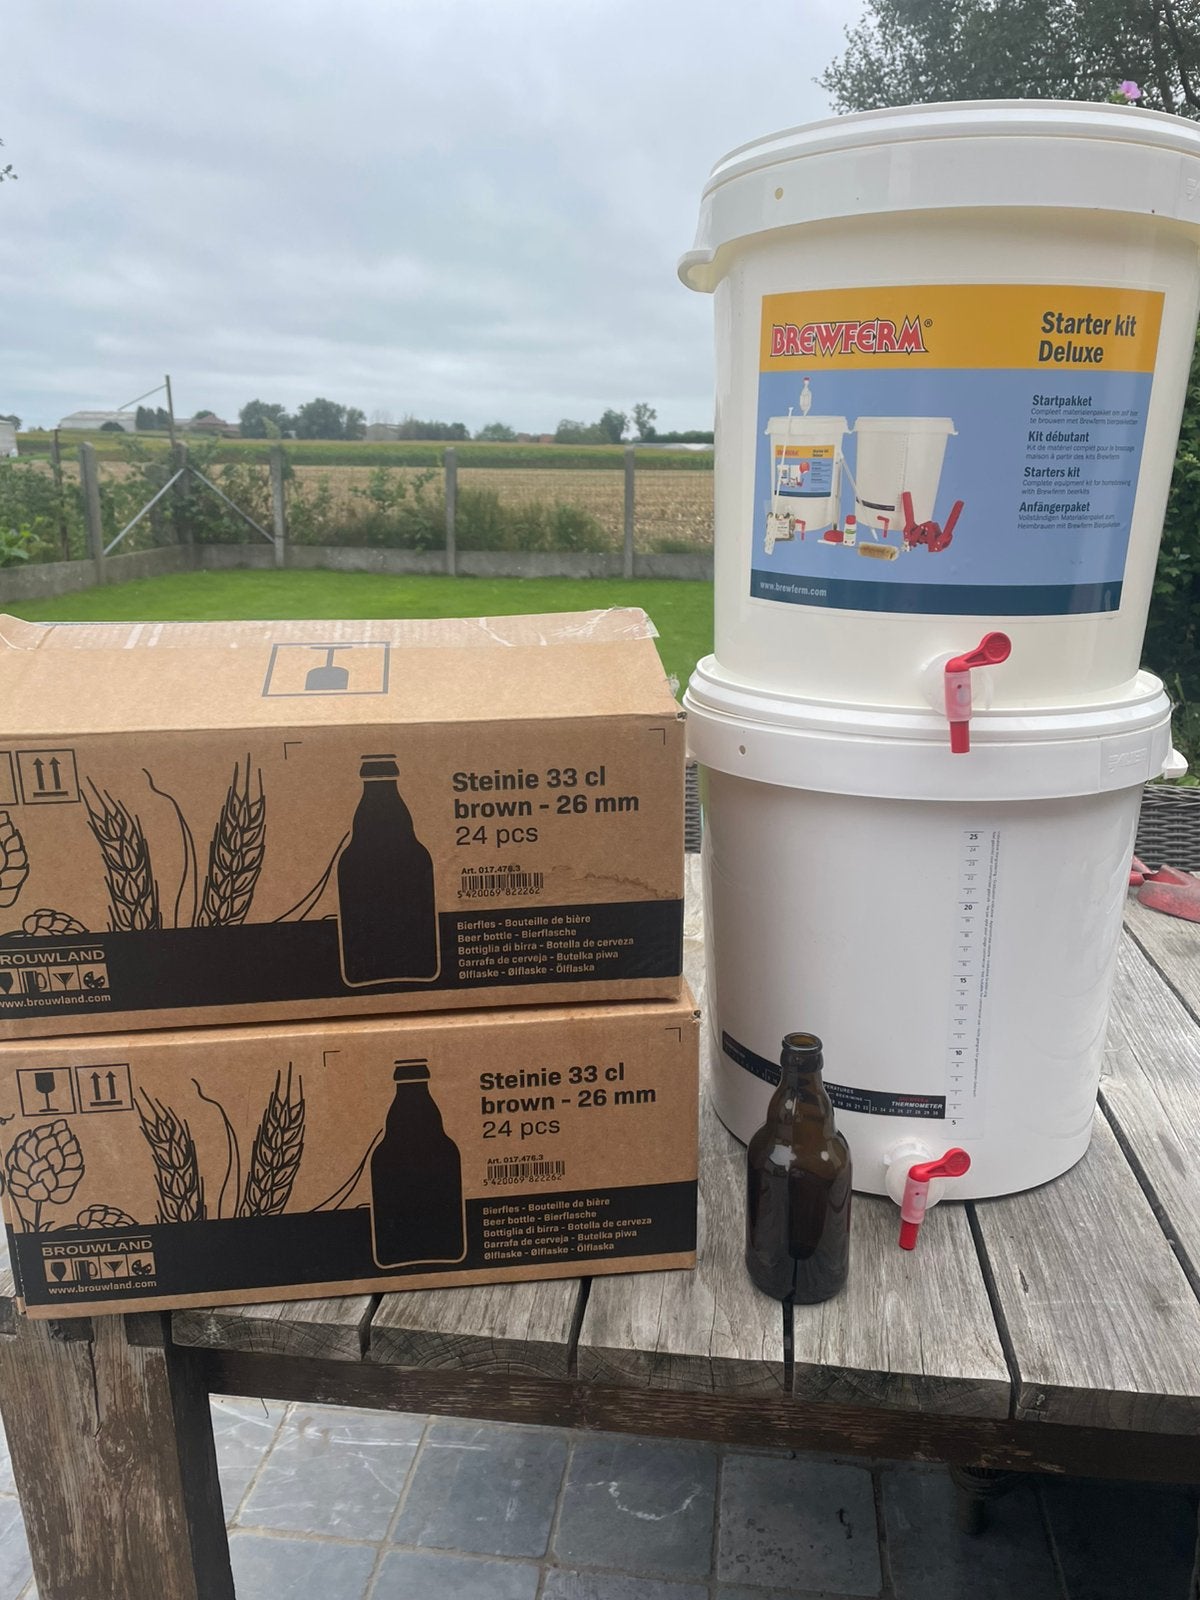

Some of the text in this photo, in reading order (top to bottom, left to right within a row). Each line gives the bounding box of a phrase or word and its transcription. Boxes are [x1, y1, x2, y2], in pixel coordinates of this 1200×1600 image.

[1041, 311, 1137, 337] Starter kit
[1038, 340, 1104, 363] Deluxe
[1032, 394, 1093, 408] Startpakket
[1031, 408, 1062, 416] Compleet
[1029, 430, 1090, 442] Kit débutant
[1024, 466, 1080, 478] Starters kit
[1019, 501, 1091, 514] Anfängerpaket
[760, 580, 827, 597] www.brewferm.com
[453, 765, 605, 792] Steinie 33 cl
[455, 799, 532, 818] brown
[557, 794, 587, 814] 26
[595, 795, 639, 812] mm
[456, 826, 539, 847] 24 pcs
[461, 866, 477, 874] Art.
[458, 886, 540, 898] 5 420069 822262
[457, 920, 496, 930] Bierfles
[505, 917, 549, 927] Bouteille
[552, 916, 564, 924] de
[566, 914, 591, 923] bière
[458, 933, 482, 943] Beer
[484, 931, 512, 941] bottle
[522, 927, 577, 938] Bierflasche
[458, 945, 500, 956] Bottiglia
[503, 944, 512, 952] di
[515, 942, 537, 950] birra
[547, 939, 581, 949] Botella
[583, 938, 595, 947] de
[597, 937, 634, 945] cerveza
[0, 950, 105, 965] ROUWLAND
[459, 957, 495, 967] Garrafa
[498, 956, 510, 965] de
[513, 953, 547, 964] cerveja
[557, 951, 593, 961] Butelka
[596, 950, 619, 960] piwa
[459, 969, 499, 979] Ølflaske
[508, 966, 547, 976] Ølflaske
[556, 962, 595, 973] Ölflaska
[480, 1062, 625, 1090] Steinie 33 cl
[824, 1083, 854, 1094] PERATURES
[482, 1096, 555, 1114] brown
[578, 1089, 607, 1108] 26
[614, 1089, 656, 1105] mm
[892, 1101, 943, 1109] THERMOMETER
[483, 1120, 560, 1139] 24 pcs
[487, 1156, 502, 1164] Art.
[483, 1173, 562, 1186] 5 420069 822262
[483, 1206, 519, 1215] Bierfles
[528, 1201, 570, 1212] Bouteille
[573, 1200, 584, 1208] de
[587, 1197, 610, 1206] bière
[483, 1217, 506, 1226] Beer
[508, 1215, 535, 1224] bottle
[544, 1210, 597, 1221] Bierflasche
[484, 1227, 523, 1238] Bottiglia
[526, 1225, 535, 1234] di
[537, 1224, 559, 1233] birra
[568, 1220, 600, 1230] Botella
[603, 1218, 614, 1227] de
[617, 1216, 652, 1226] cerveza
[484, 1239, 519, 1249] Garrafa
[522, 1237, 533, 1246] de
[535, 1234, 569, 1245] cerveja
[578, 1231, 613, 1241] Butelka
[615, 1229, 637, 1239] piwa
[42, 1240, 153, 1256] BROUWLAND
[484, 1250, 522, 1260] Ølflaske
[531, 1246, 568, 1256] Ølflaske
[577, 1242, 615, 1252] Ölflaska
[49, 1280, 157, 1294] www.brouwland.com
